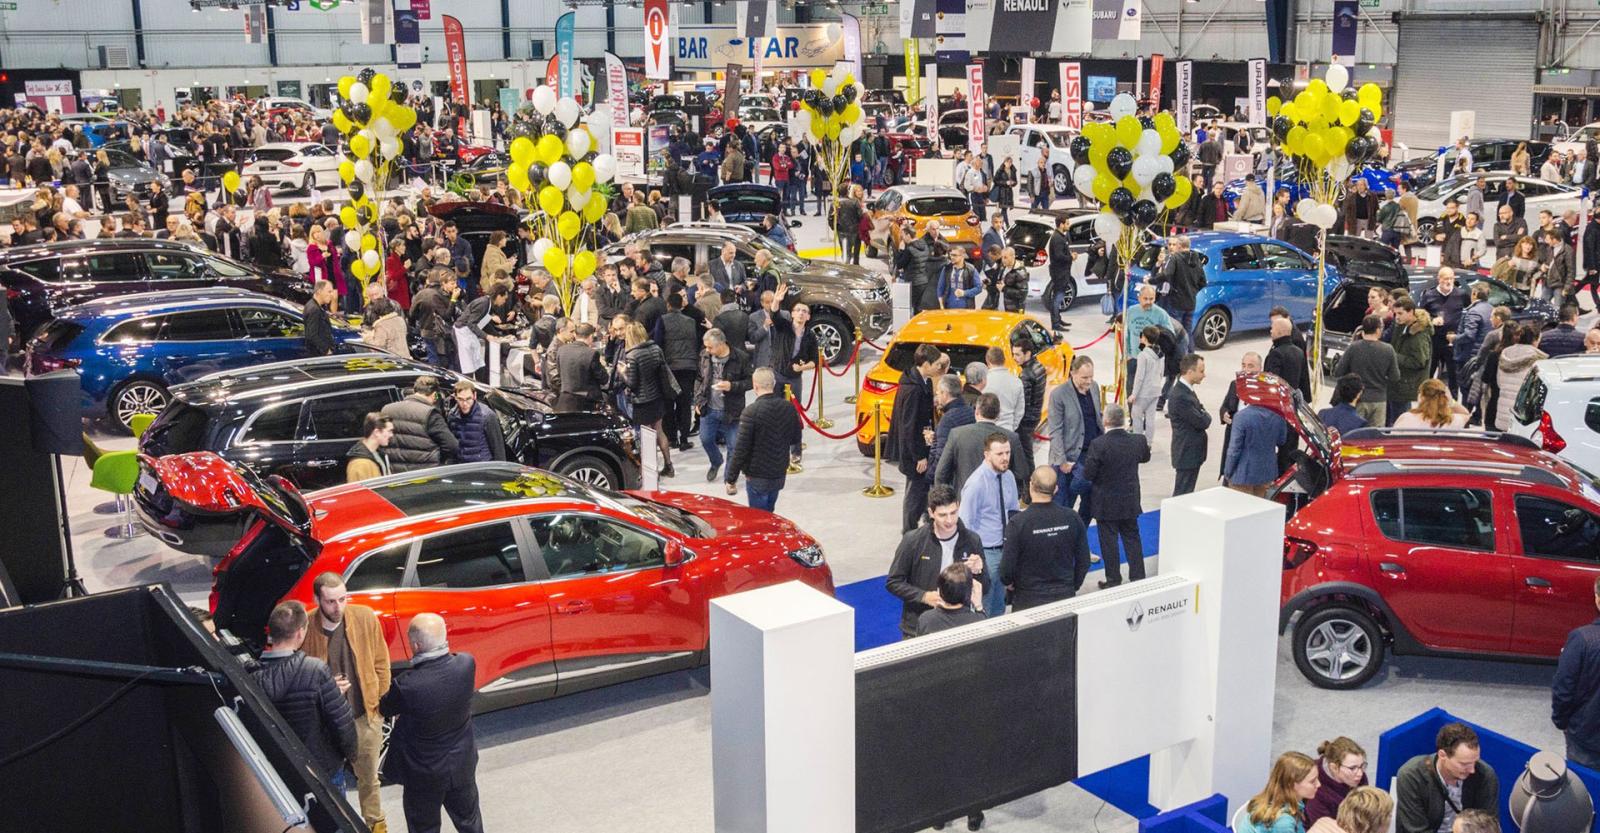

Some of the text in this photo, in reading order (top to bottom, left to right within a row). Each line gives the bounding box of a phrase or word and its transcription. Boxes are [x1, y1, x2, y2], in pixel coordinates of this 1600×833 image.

[1093, 10, 1117, 20] SUBARU
[678, 36, 708, 59] BAR
[1148, 598, 1188, 616] RENAULT
